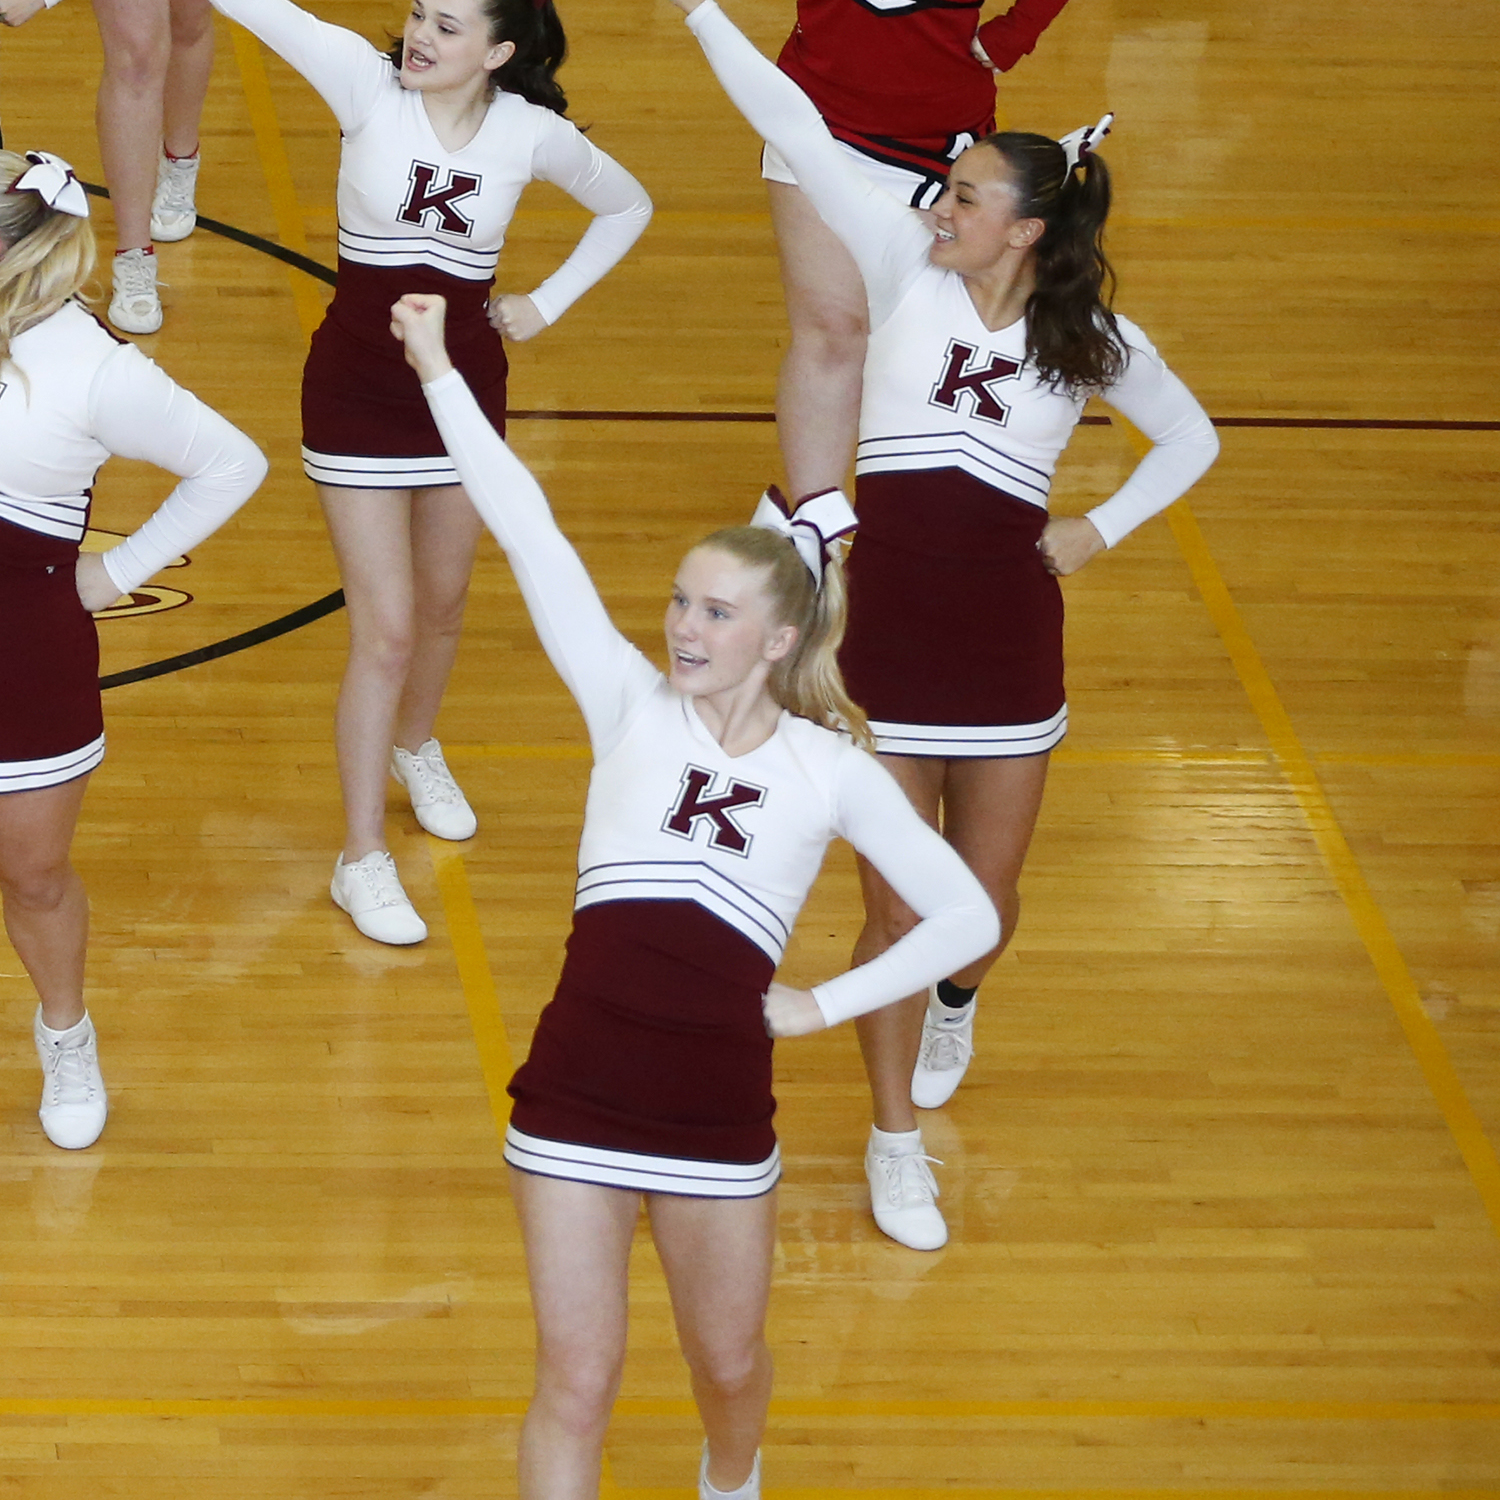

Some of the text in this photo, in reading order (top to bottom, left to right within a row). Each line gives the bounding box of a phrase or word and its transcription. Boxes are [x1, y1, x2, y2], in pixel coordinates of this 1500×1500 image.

[395, 159, 483, 239] K
[927, 336, 1025, 429] K
[661, 762, 769, 859] K
